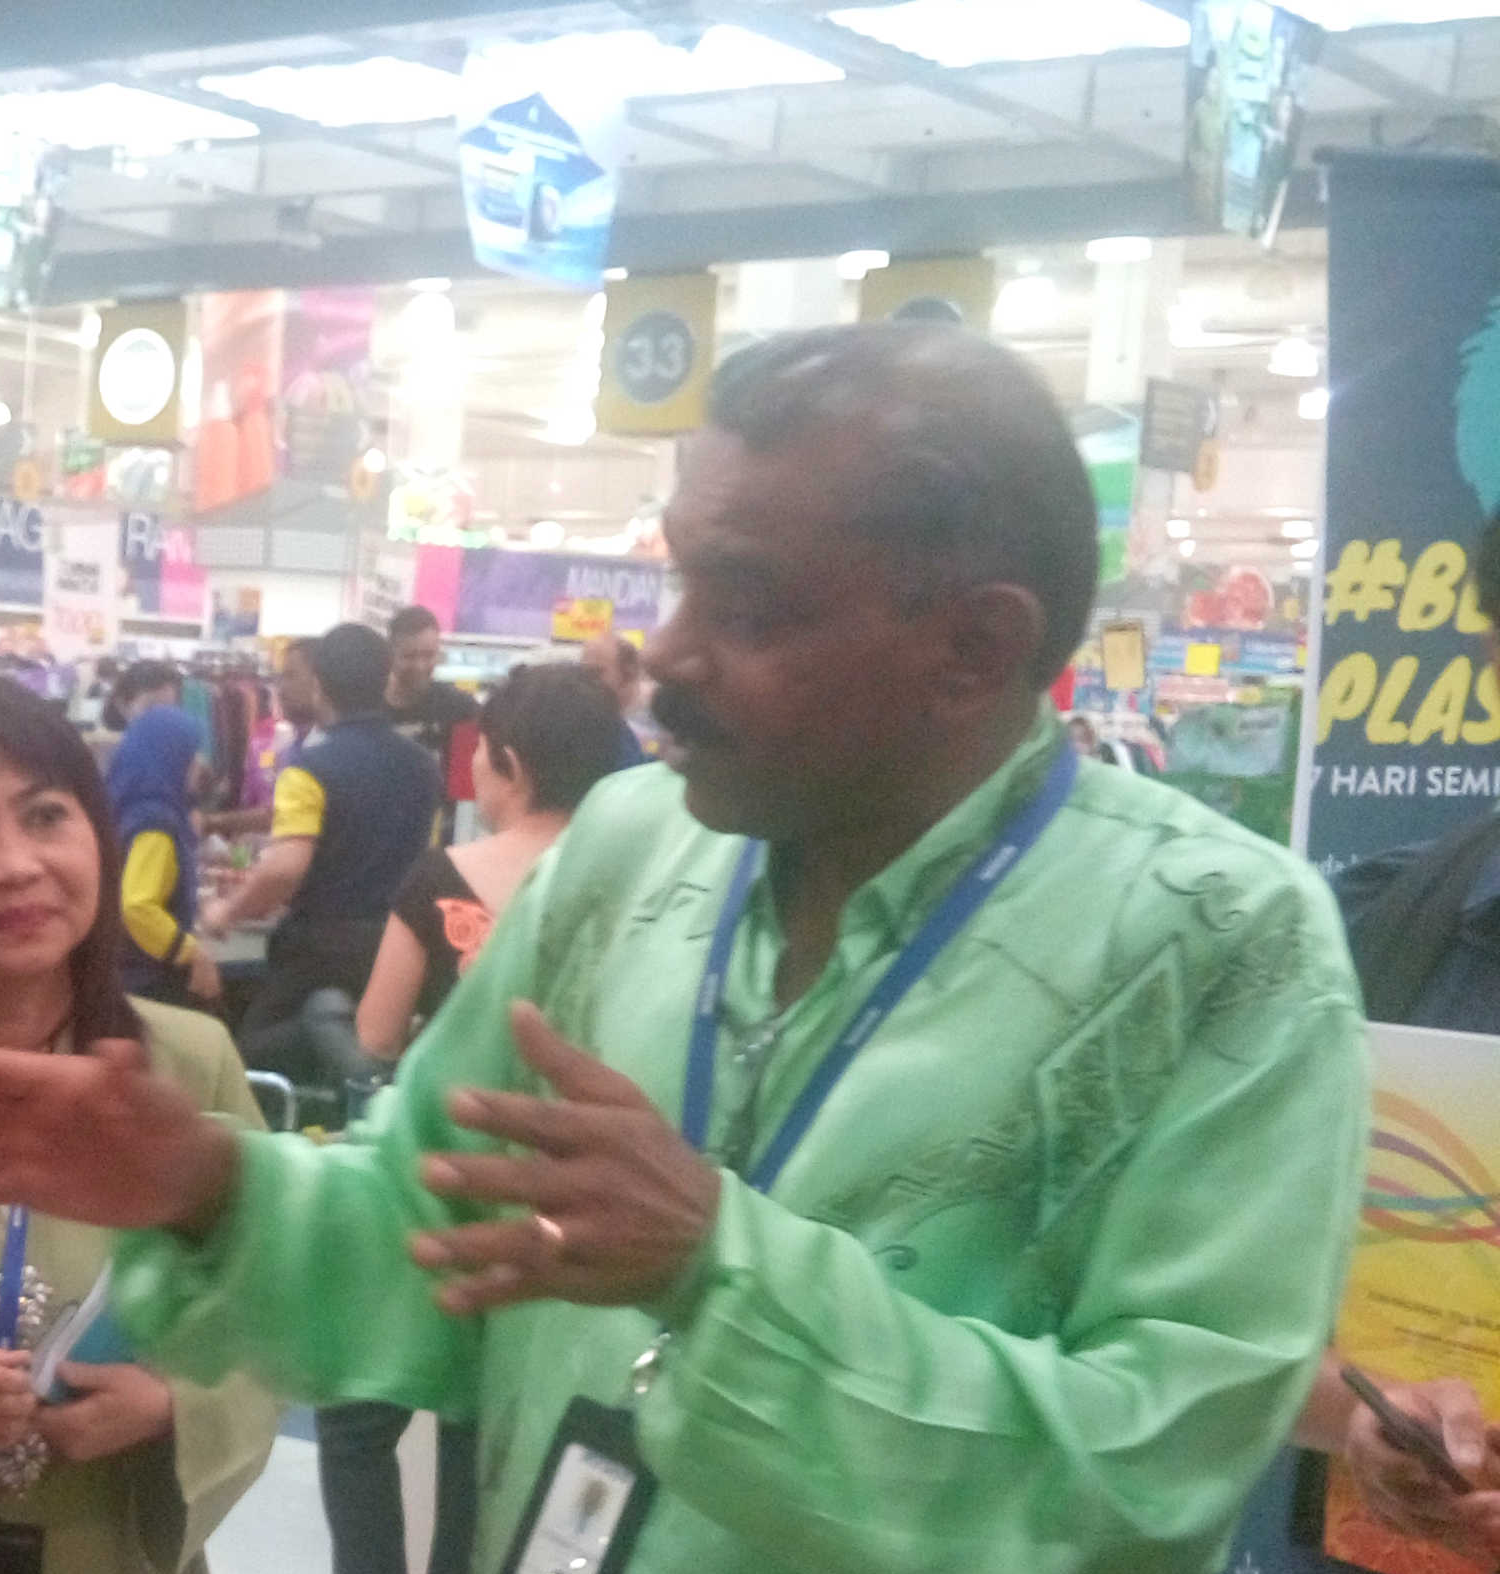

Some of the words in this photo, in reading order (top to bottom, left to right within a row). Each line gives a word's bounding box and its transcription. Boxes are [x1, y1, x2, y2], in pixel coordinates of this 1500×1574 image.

[626, 333, 684, 379] 33
[1316, 651, 1500, 746] PLAS
[1330, 765, 1417, 796] HARI
[1426, 765, 1500, 797] SEMI
